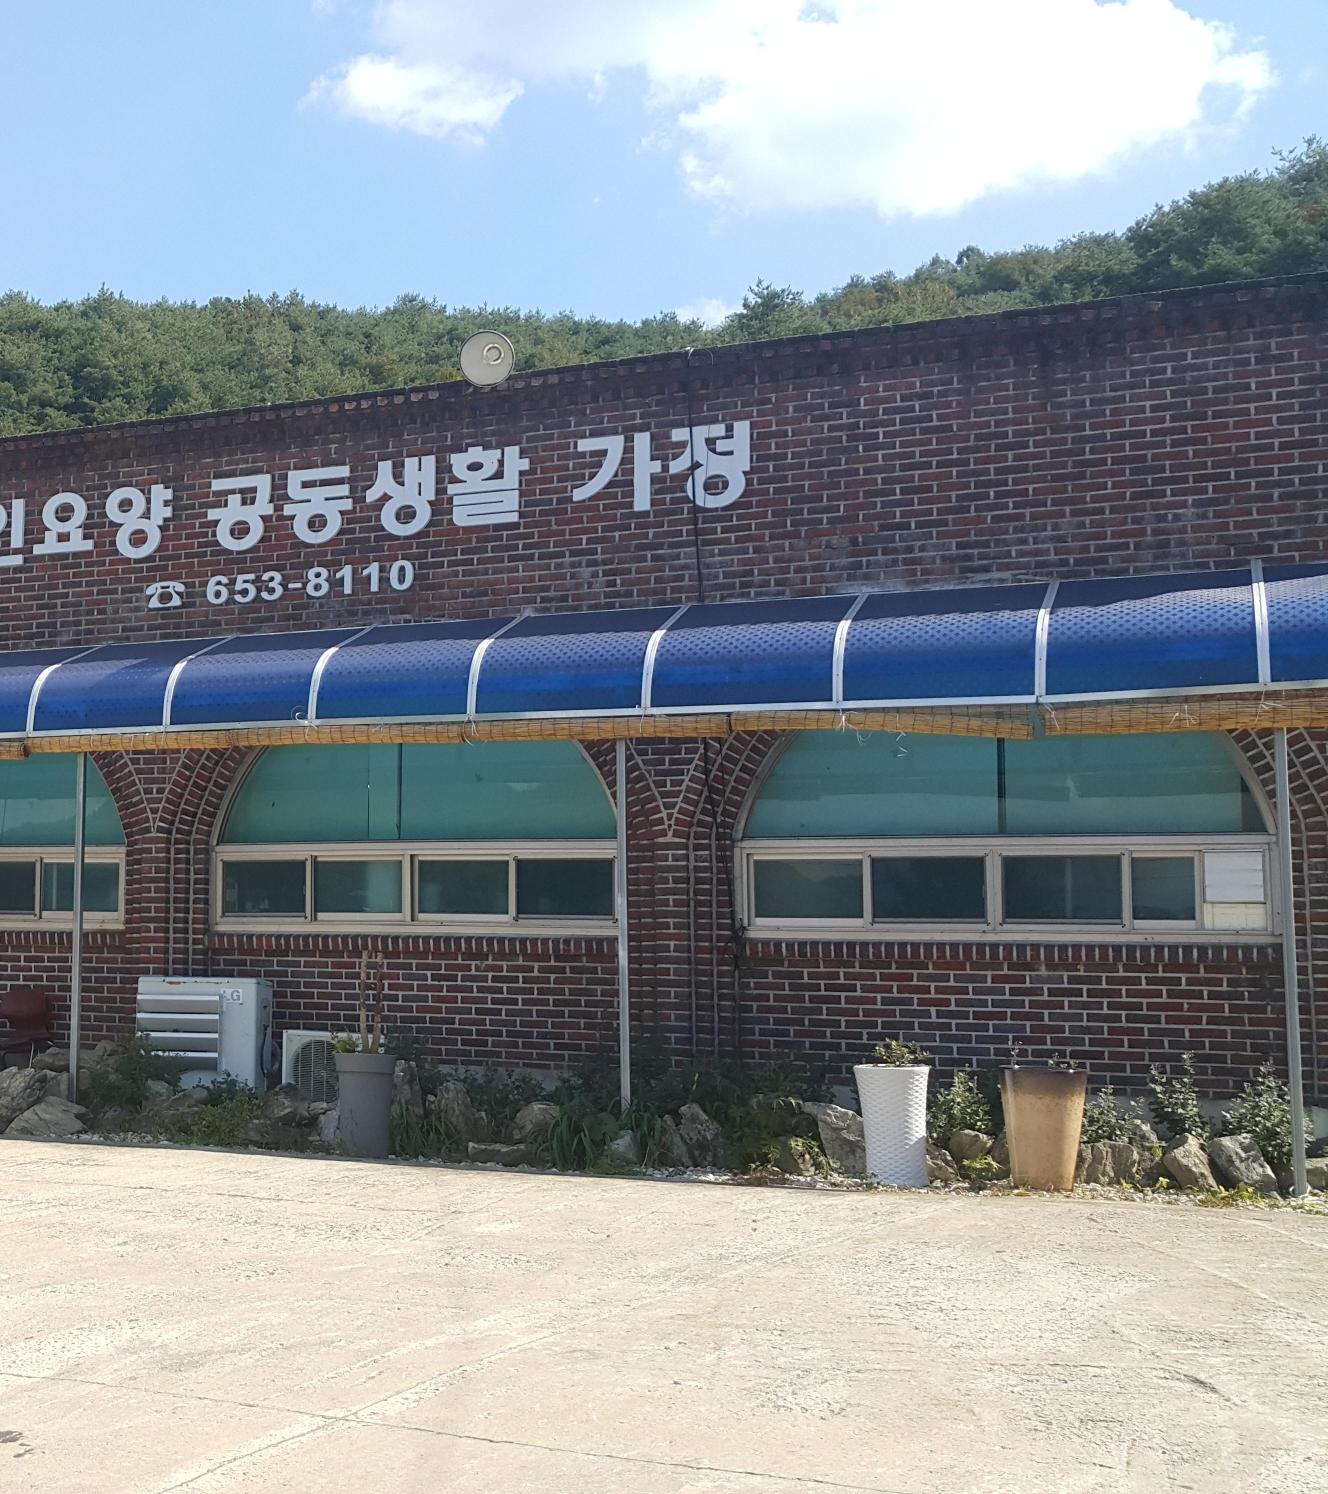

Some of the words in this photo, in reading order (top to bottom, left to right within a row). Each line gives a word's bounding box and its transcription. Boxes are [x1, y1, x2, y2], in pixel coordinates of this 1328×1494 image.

[207, 445, 530, 551] 공동생활
[572, 421, 751, 512] 가정
[206, 559, 415, 605] 653-8110
